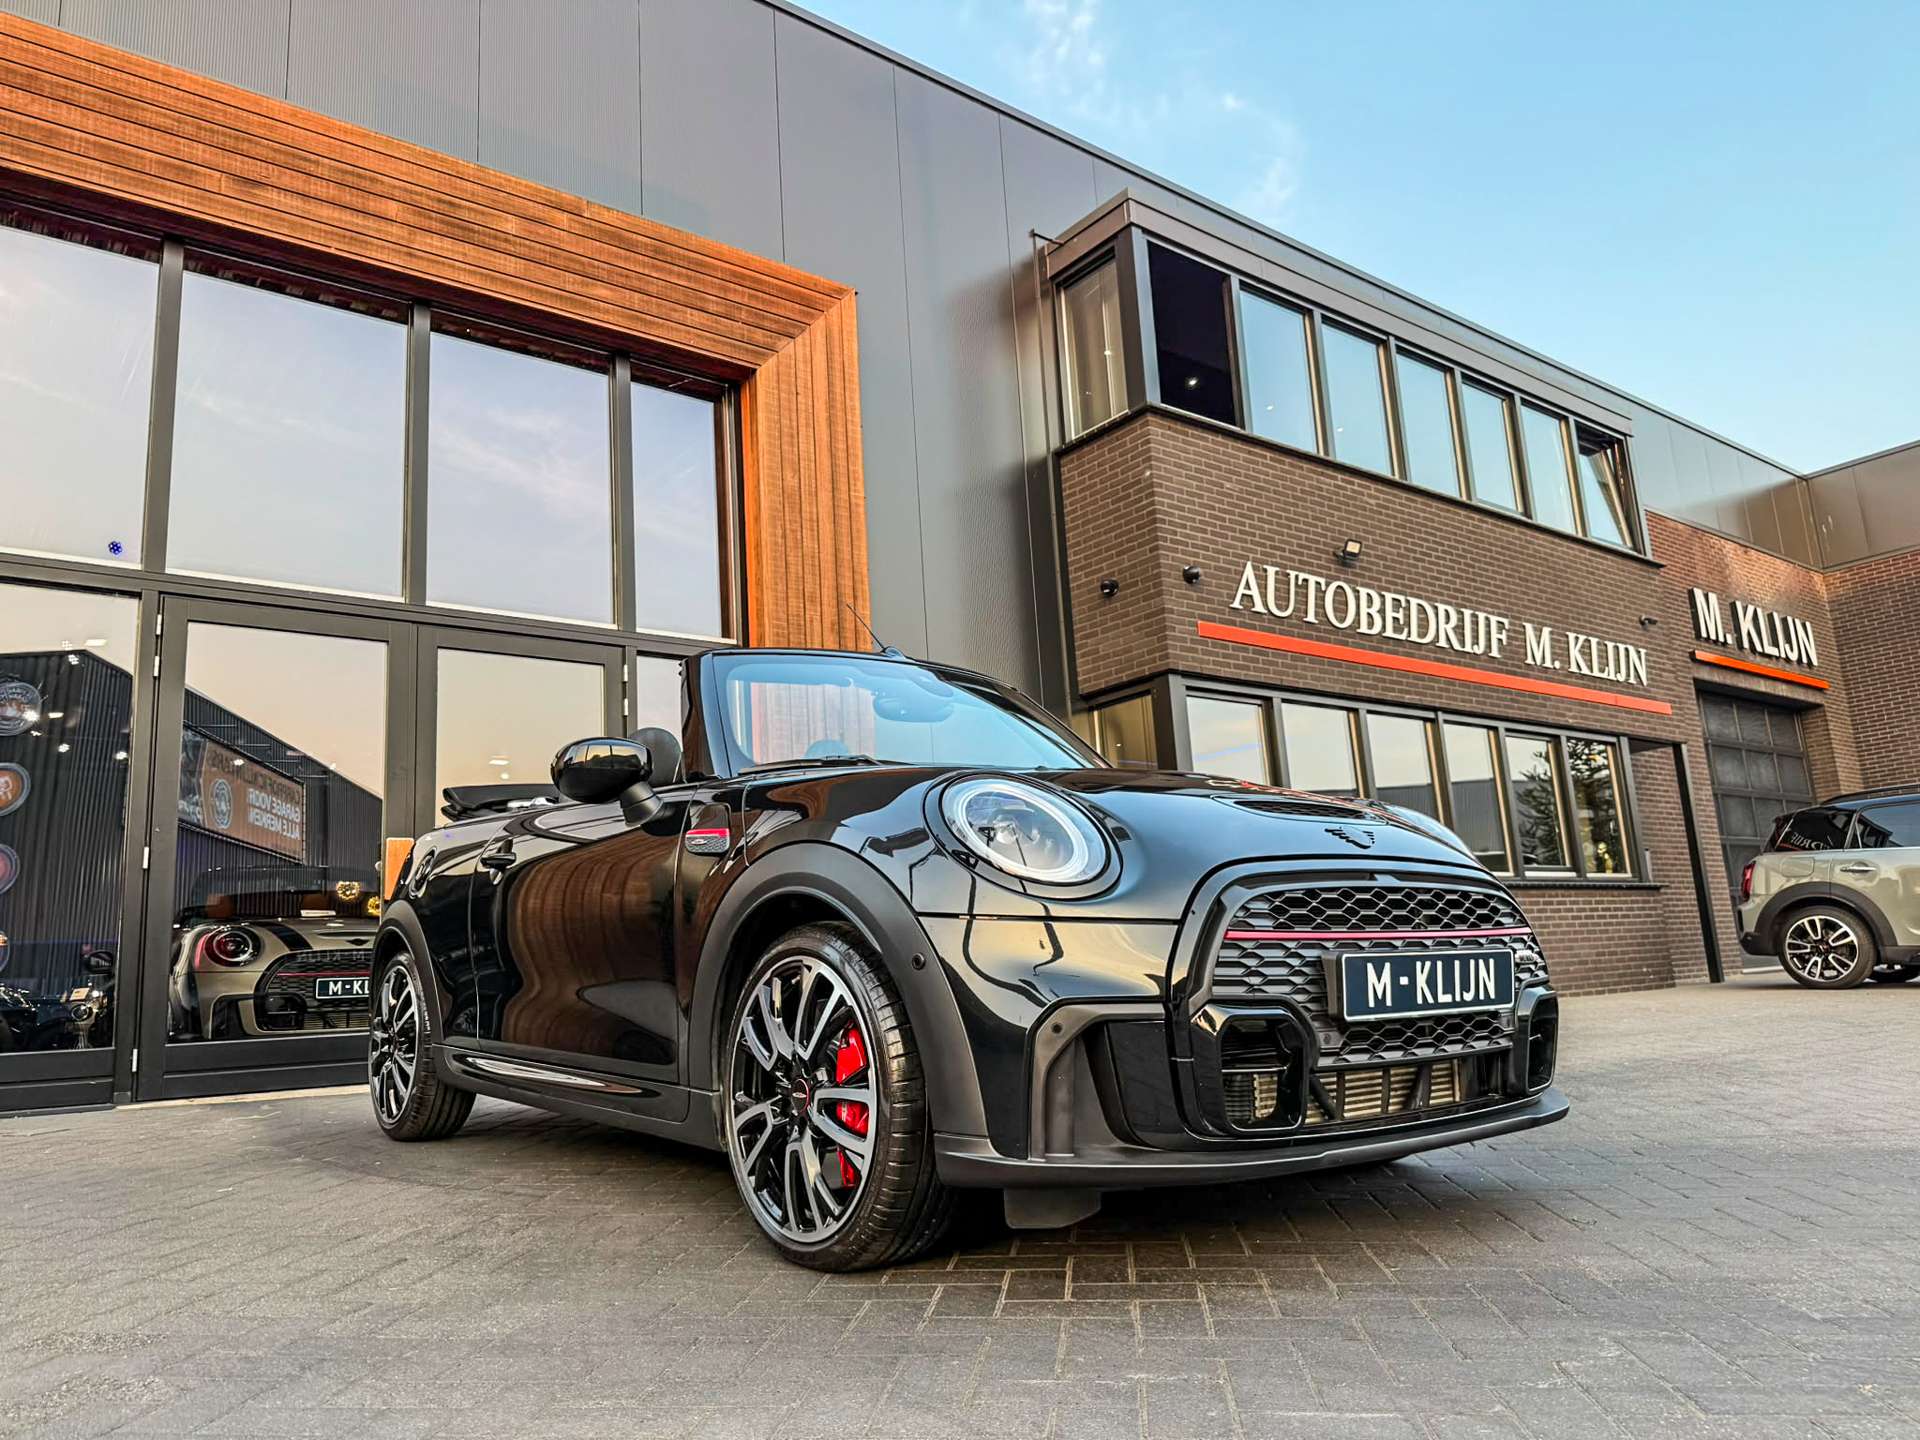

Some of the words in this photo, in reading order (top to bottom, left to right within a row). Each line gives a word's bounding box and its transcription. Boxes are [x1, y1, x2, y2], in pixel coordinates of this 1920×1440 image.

[1229, 560, 1509, 658] AUTOBEDRIJF
[1522, 622, 1560, 670] M.
[1566, 631, 1647, 687] KLIJN
[1690, 587, 1733, 645] M.
[1734, 600, 1818, 667] KLIJN
